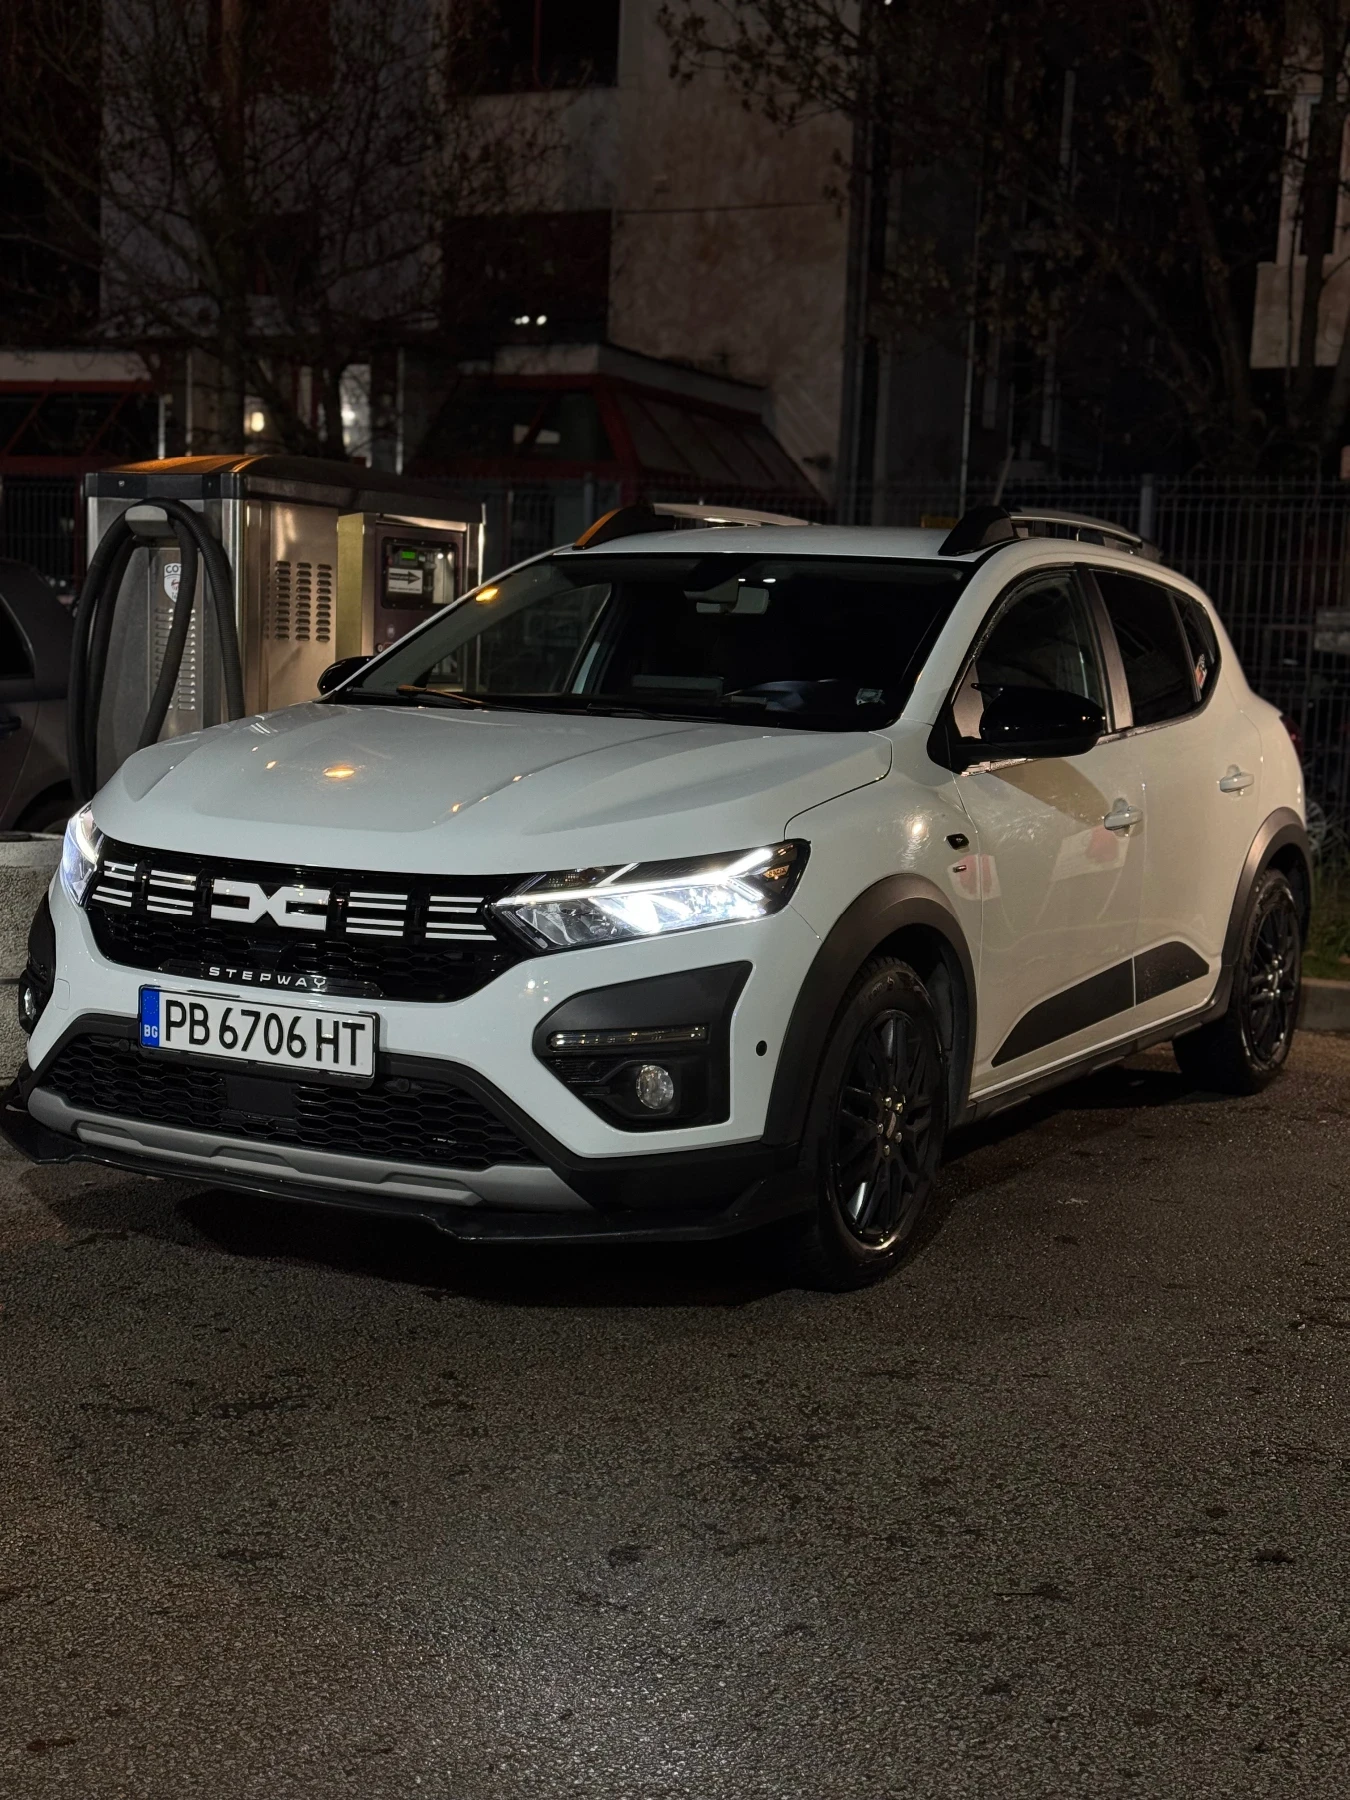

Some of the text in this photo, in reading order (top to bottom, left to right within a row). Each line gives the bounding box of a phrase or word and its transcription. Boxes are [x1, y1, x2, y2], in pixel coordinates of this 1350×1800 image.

[165, 564, 181, 574] CO
[208, 966, 327, 988] STEPWAY
[144, 1024, 158, 1038] BG
[165, 999, 366, 1066] PB 6706 HT
